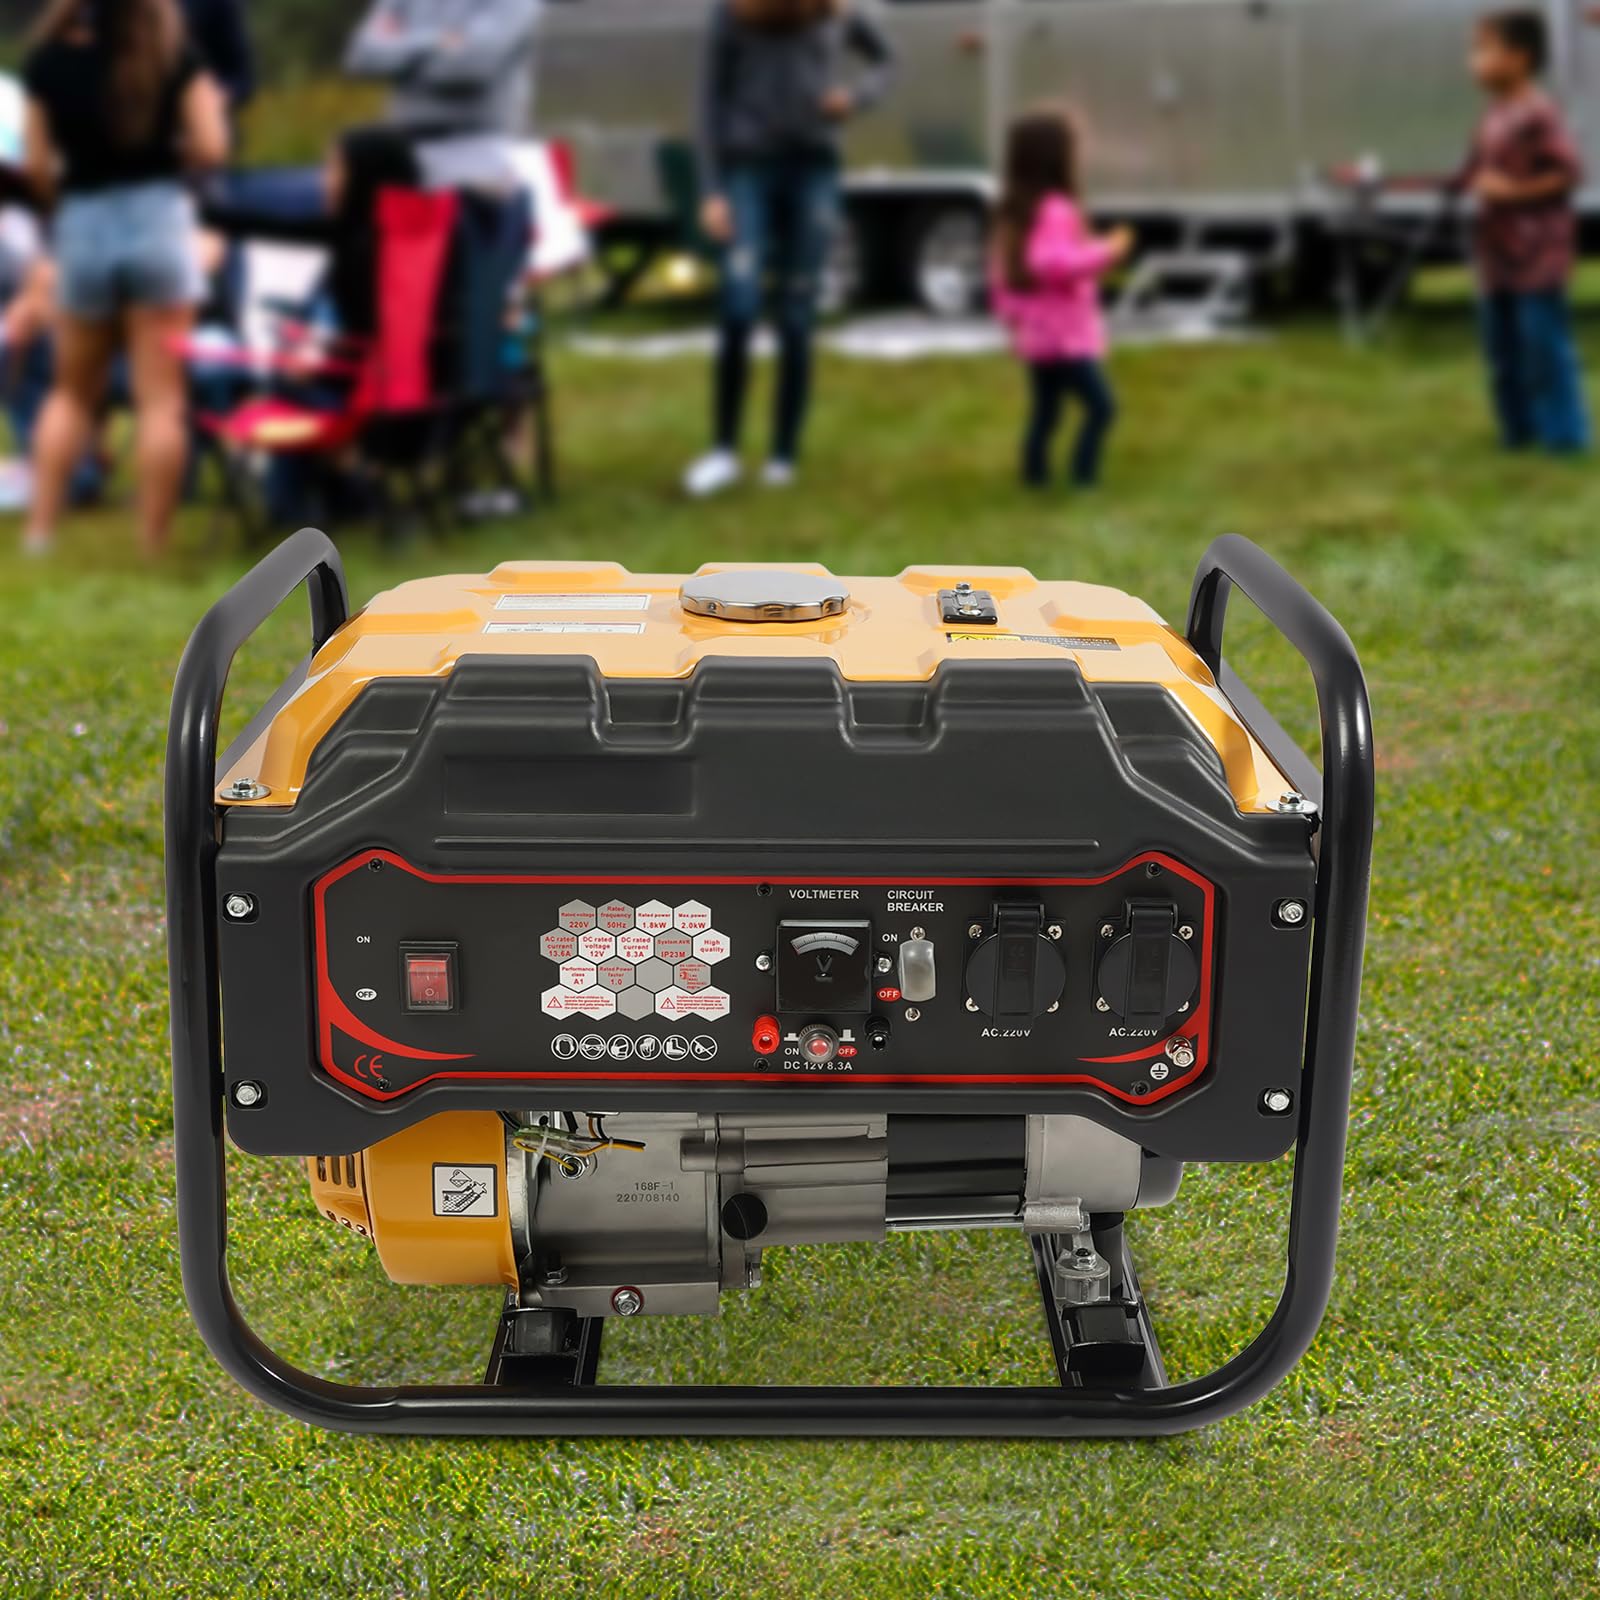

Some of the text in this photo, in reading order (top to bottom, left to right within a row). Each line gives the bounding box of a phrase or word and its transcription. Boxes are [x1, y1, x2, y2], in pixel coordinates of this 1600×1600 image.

[789, 890, 860, 899] VOLTMETER
[887, 890, 934, 900] CIRCUIT
[887, 902, 944, 912] BREAKER
[356, 936, 371, 944] ON
[882, 934, 898, 942] ON
[879, 990, 899, 998] OFF
[354, 1054, 382, 1078] CE
[784, 1062, 800, 1070] DC
[827, 1062, 853, 1070] 8.3A
[616, 1193, 680, 1202] 220708140
